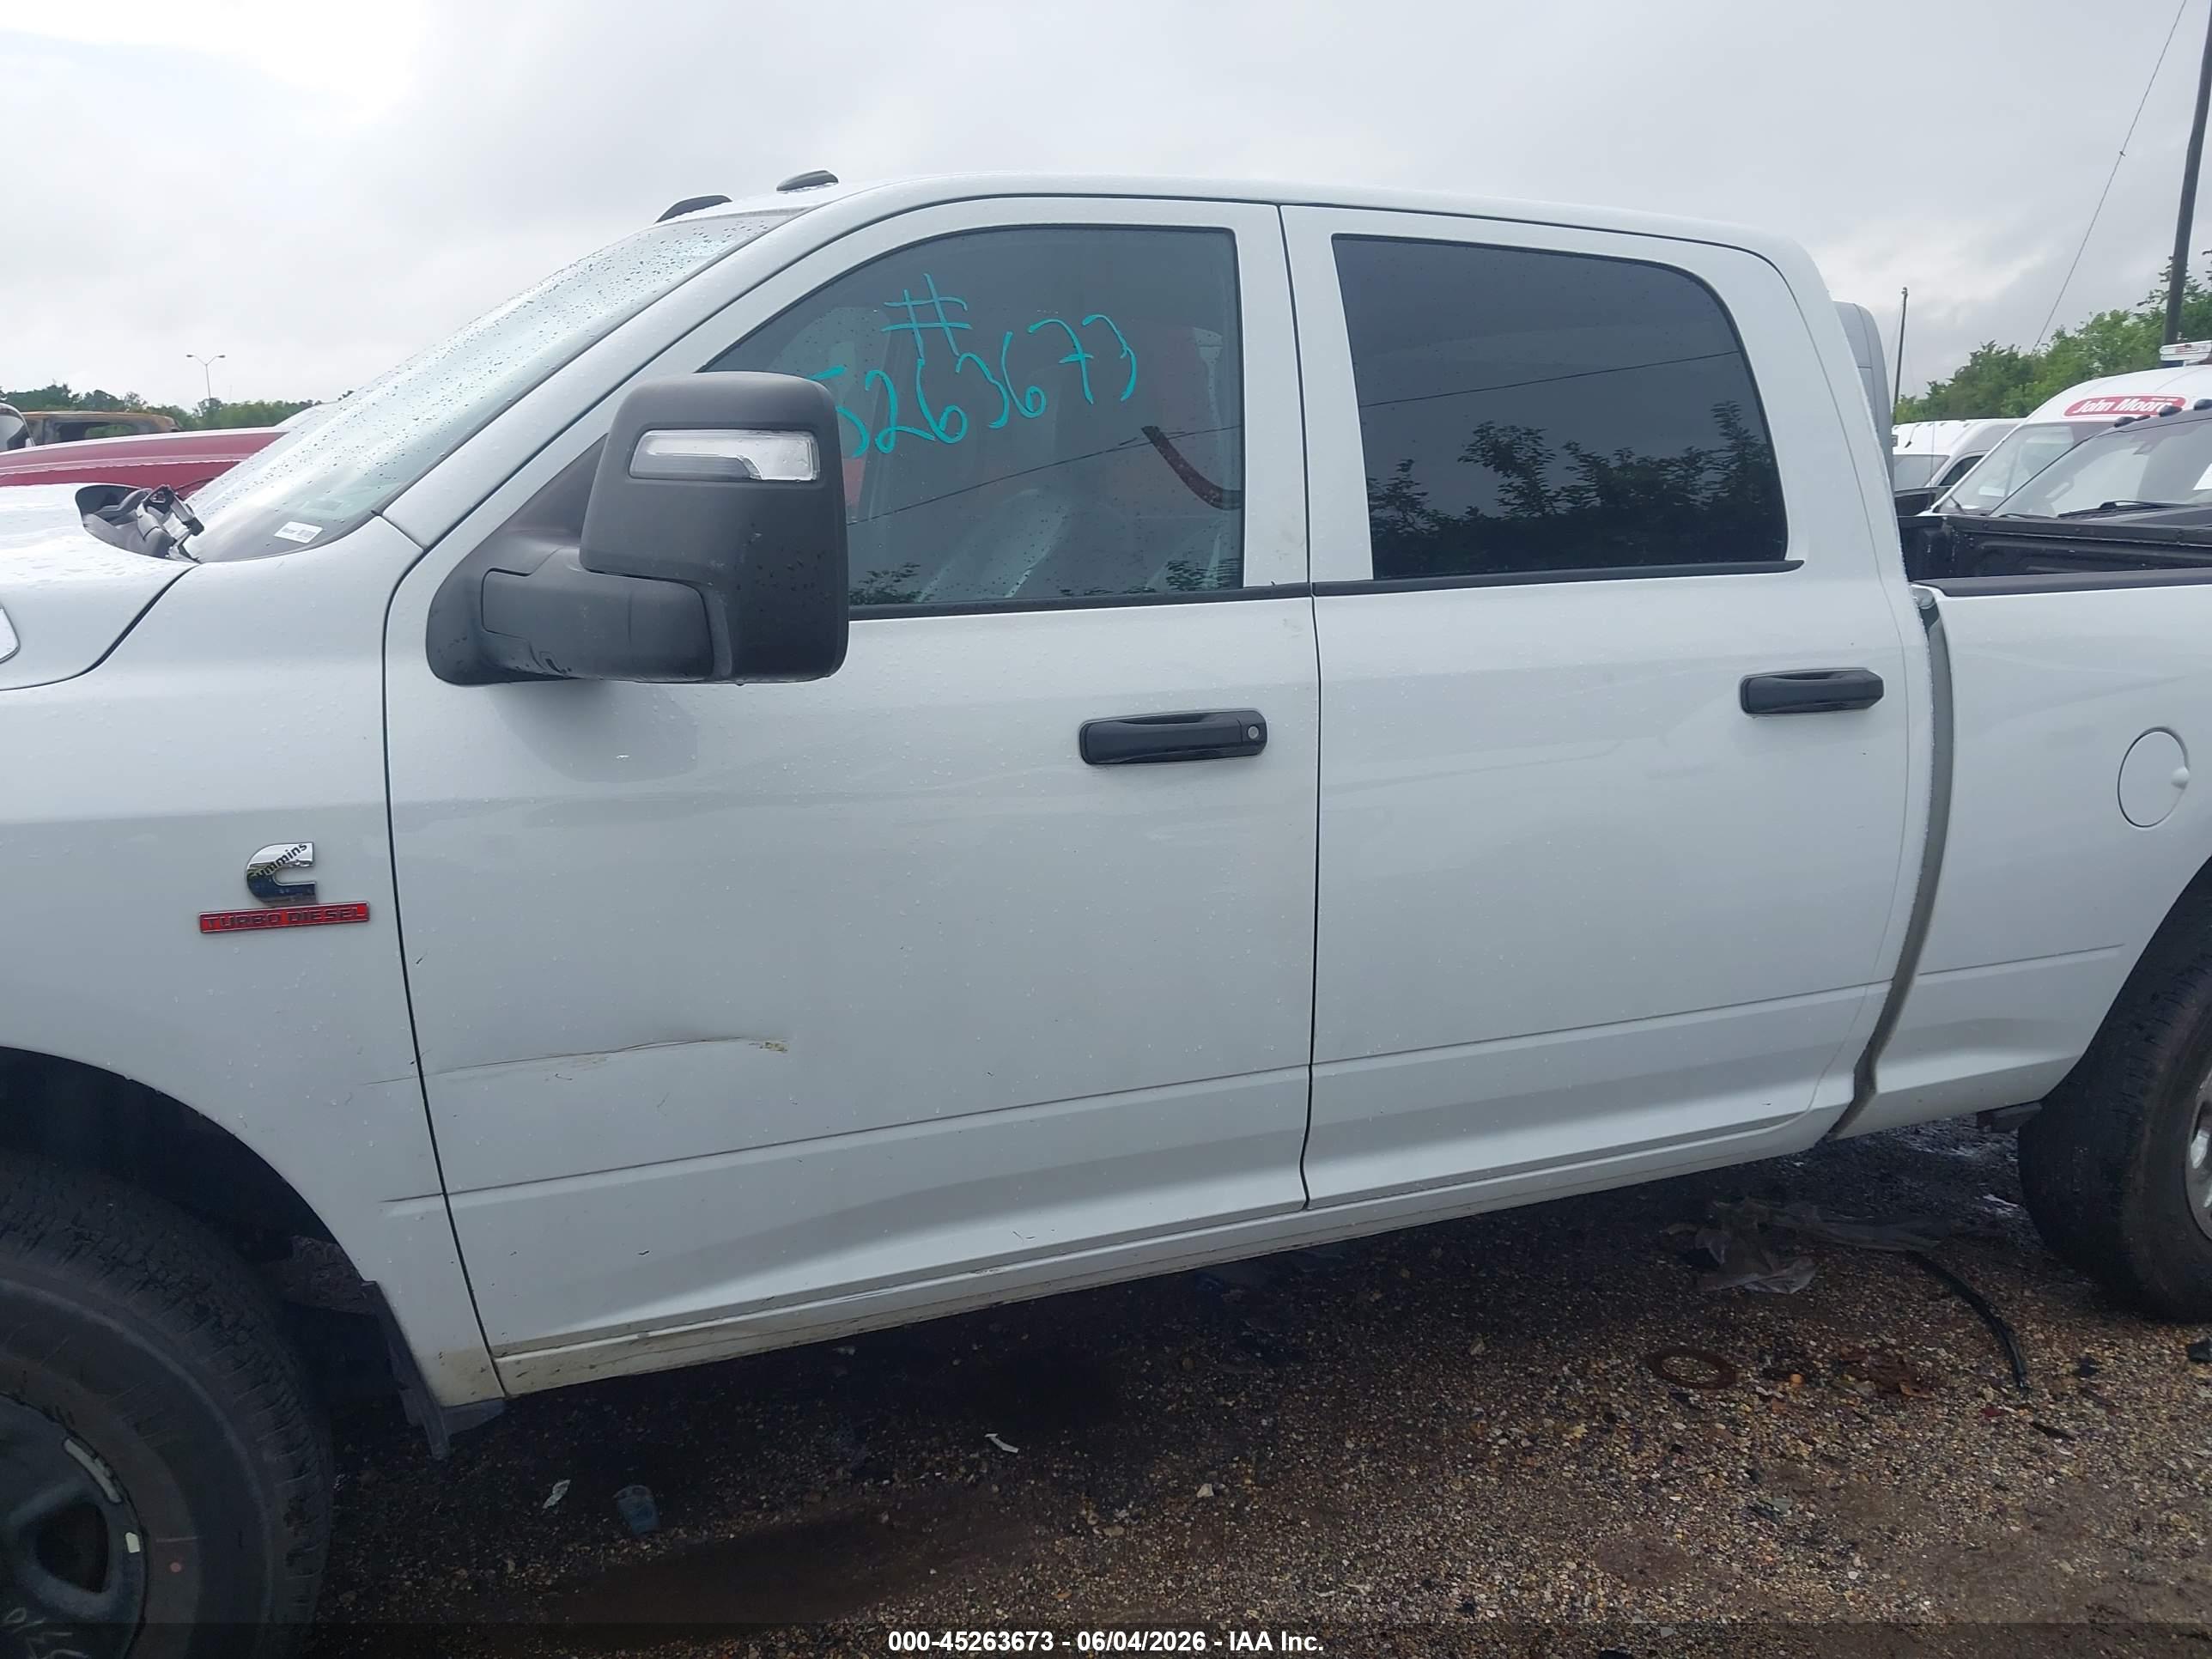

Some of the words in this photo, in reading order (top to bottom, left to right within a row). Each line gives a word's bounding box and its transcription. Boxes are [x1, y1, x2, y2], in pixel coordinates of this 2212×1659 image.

[881, 272, 973, 361] #
[2072, 398, 2115, 413] John
[202, 911, 282, 928] TURBO
[286, 906, 366, 922] DIESEL
